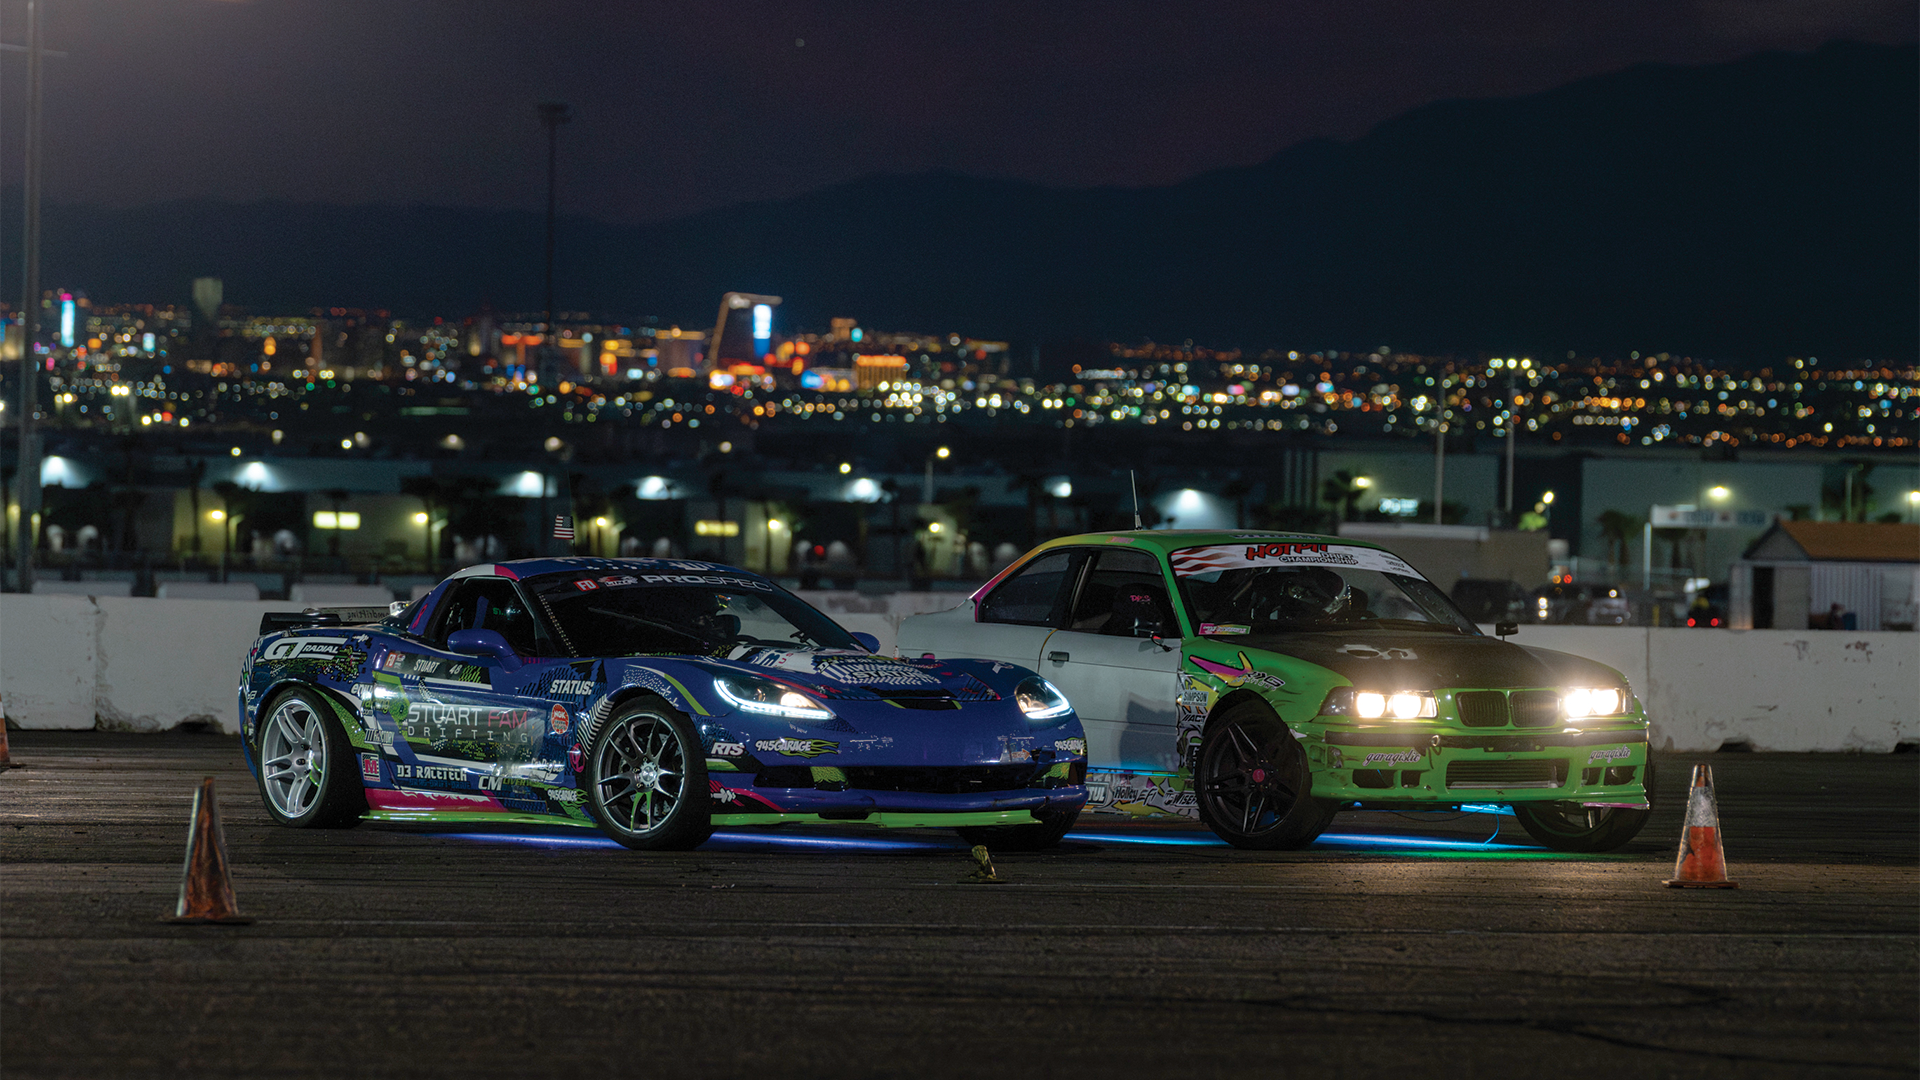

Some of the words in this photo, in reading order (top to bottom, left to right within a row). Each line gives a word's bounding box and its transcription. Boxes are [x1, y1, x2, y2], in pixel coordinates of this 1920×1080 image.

[1279, 555, 1359, 565] CHAMPIONSHIP
[580, 580, 597, 591] FD
[641, 575, 773, 592] PROSPEC
[262, 636, 348, 661] GT
[302, 644, 340, 654] RADIAL
[413, 659, 441, 674] STUART
[448, 664, 463, 676] 48
[1184, 691, 1208, 702] SIMPSON
[408, 704, 482, 727] STUART
[488, 709, 528, 730] FAM
[407, 725, 528, 743] DRIFTING
[711, 741, 745, 756] RTS
[755, 740, 811, 752] 945GARAGE
[416, 765, 467, 782] RACETECH
[479, 776, 502, 791] CM
